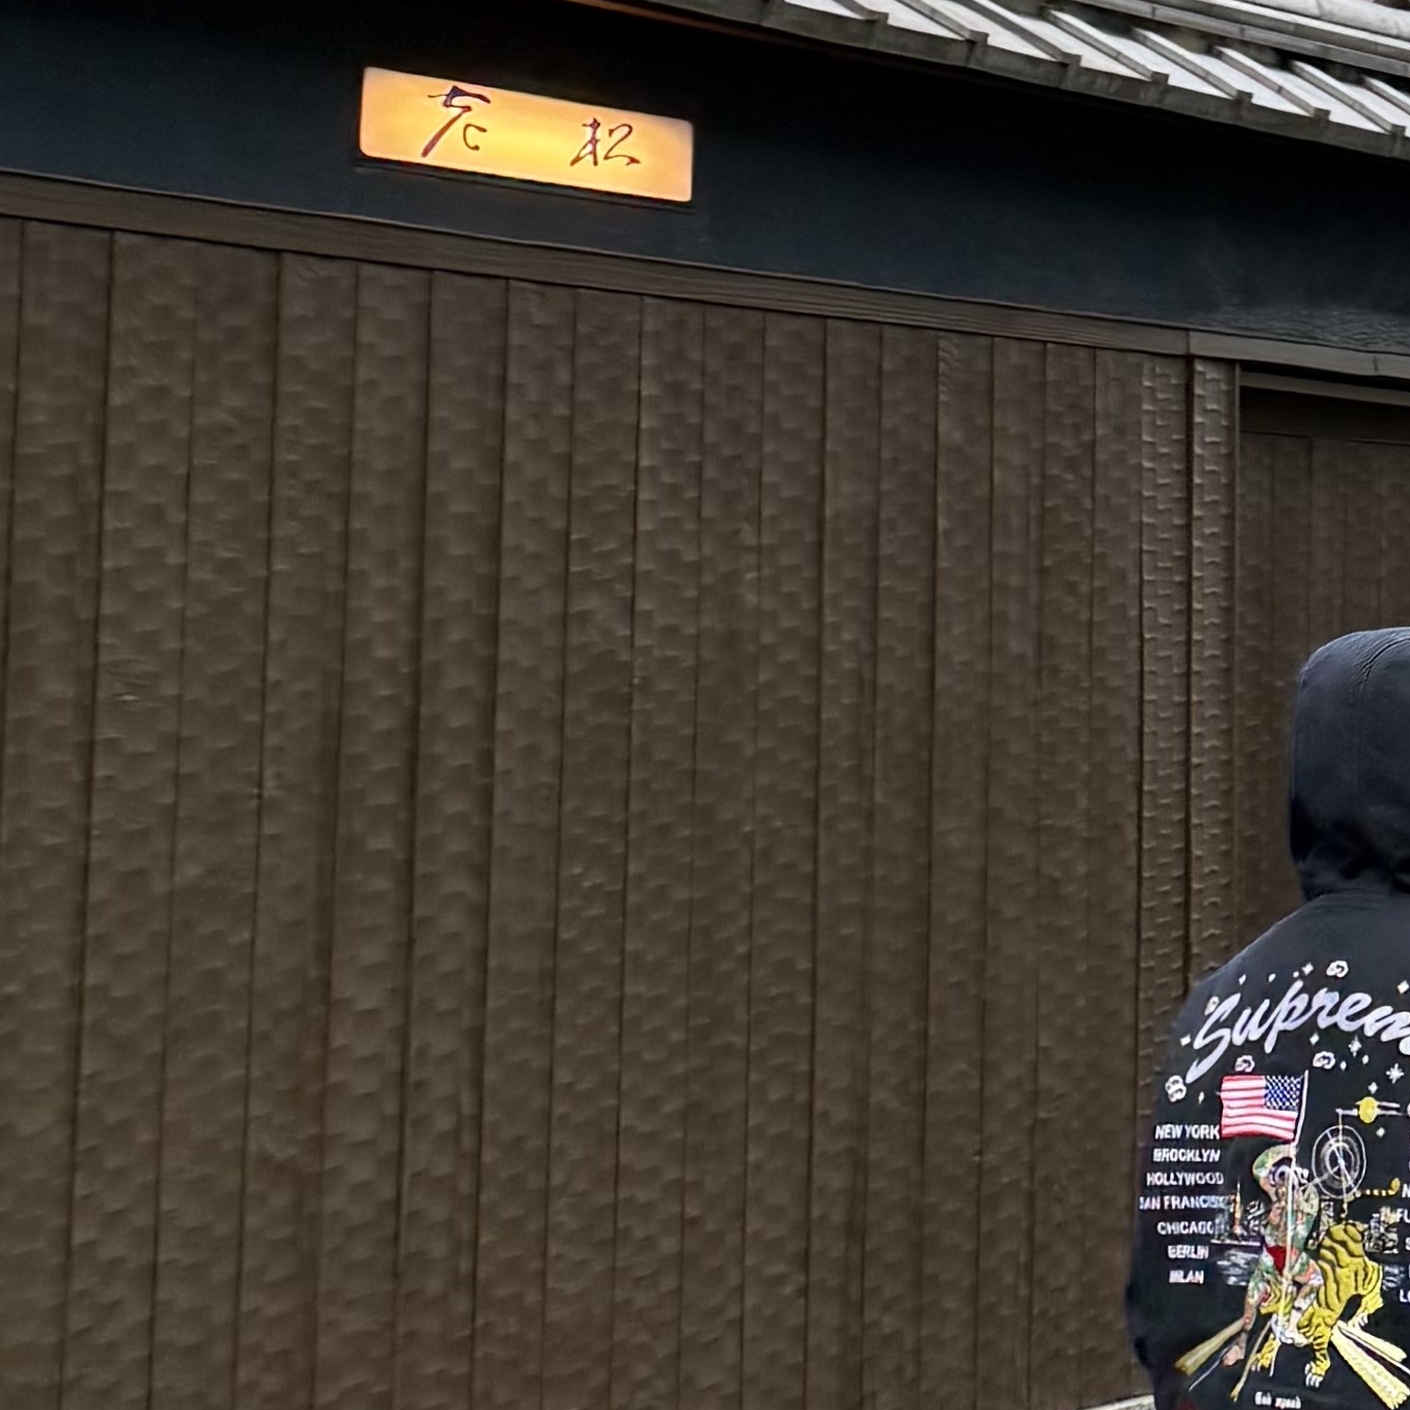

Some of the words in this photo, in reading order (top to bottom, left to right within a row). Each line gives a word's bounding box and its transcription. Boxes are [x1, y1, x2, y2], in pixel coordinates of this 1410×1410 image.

[1154, 1124, 1183, 1140] NEW
[1184, 1124, 1220, 1140] YORK
[1146, 1171, 1225, 1187] HOLLYWOOD
